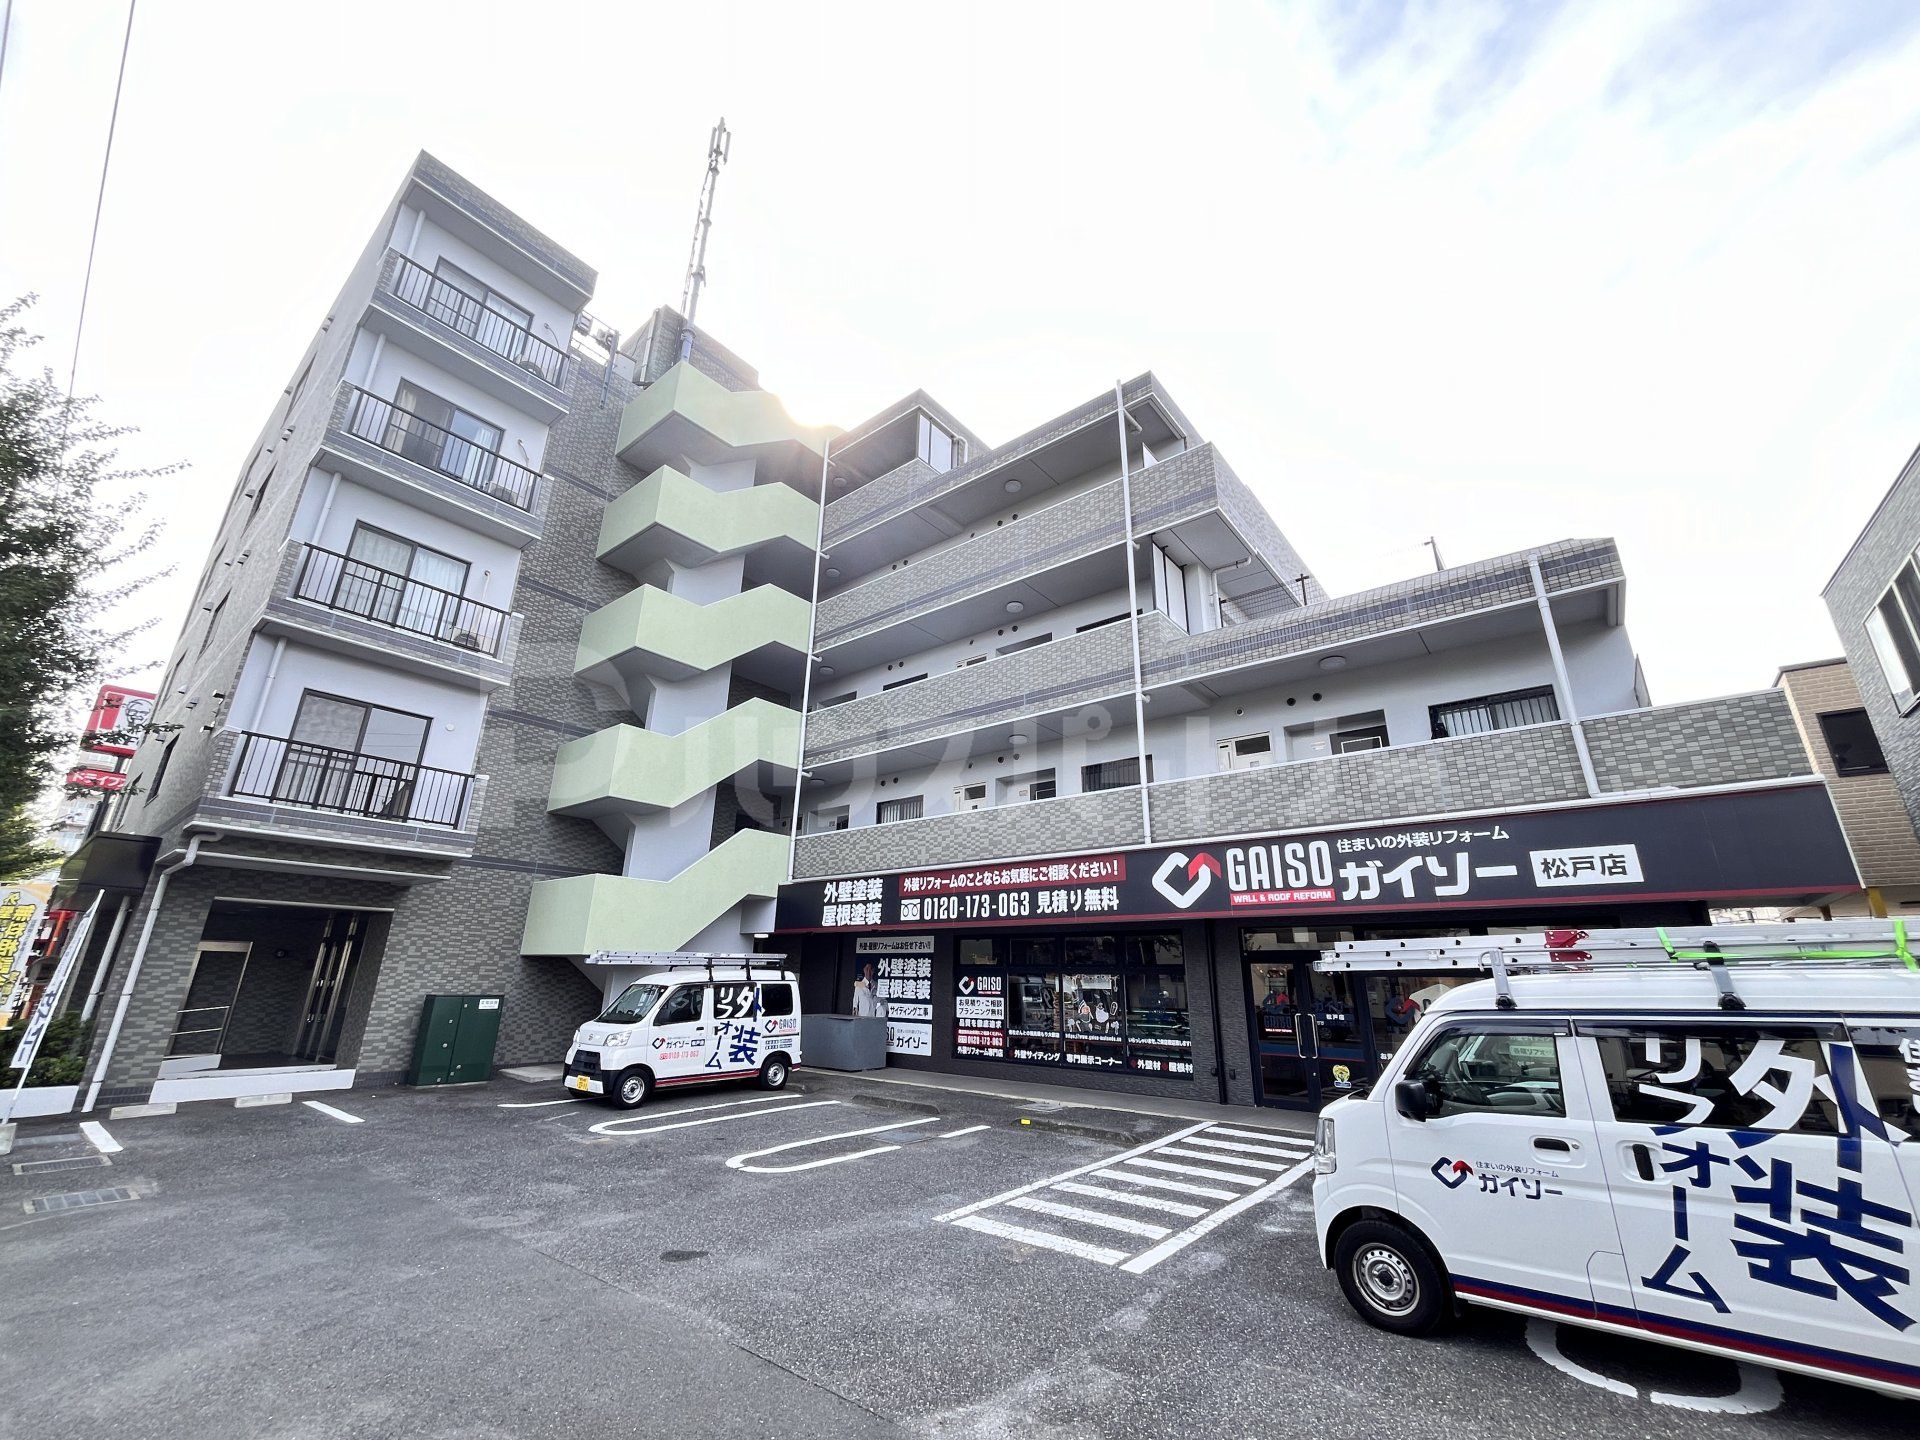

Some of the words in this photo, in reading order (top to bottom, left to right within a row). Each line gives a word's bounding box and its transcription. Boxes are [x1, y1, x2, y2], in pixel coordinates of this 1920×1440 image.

[1336, 826, 1510, 853] 住まいの外装リフォーム
[1225, 840, 1334, 891] GAISO
[1339, 852, 1518, 900] ガイソー
[1540, 853, 1628, 879] 松戸店
[824, 878, 883, 903] 外壁塗装
[1233, 895, 1257, 903] WALL
[1259, 893, 1266, 902] &
[1268, 892, 1290, 902] ROOF
[1293, 890, 1332, 900] REFORM
[923, 891, 1030, 920] 0120-173-063
[1036, 886, 1119, 914] 見積り無料
[822, 903, 882, 927] 屋根塗装
[877, 958, 932, 977] 外壁塗装
[876, 979, 931, 999] 屋根塗装
[977, 976, 1002, 990] GAISO
[890, 1006, 929, 1017] サイディング工事
[705, 986, 734, 1069] リフォーム
[666, 1040, 690, 1049] ガイソー
[896, 1036, 928, 1049] ガイソー
[1014, 1049, 1060, 1062] 外壁サイディング
[1066, 1053, 1122, 1067] 専門展示コーナー
[1475, 1160, 1559, 1178] 住まいの外装リフォーム
[1639, 1037, 1732, 1314] リフォーム
[1478, 1173, 1563, 1200] ガイソー
